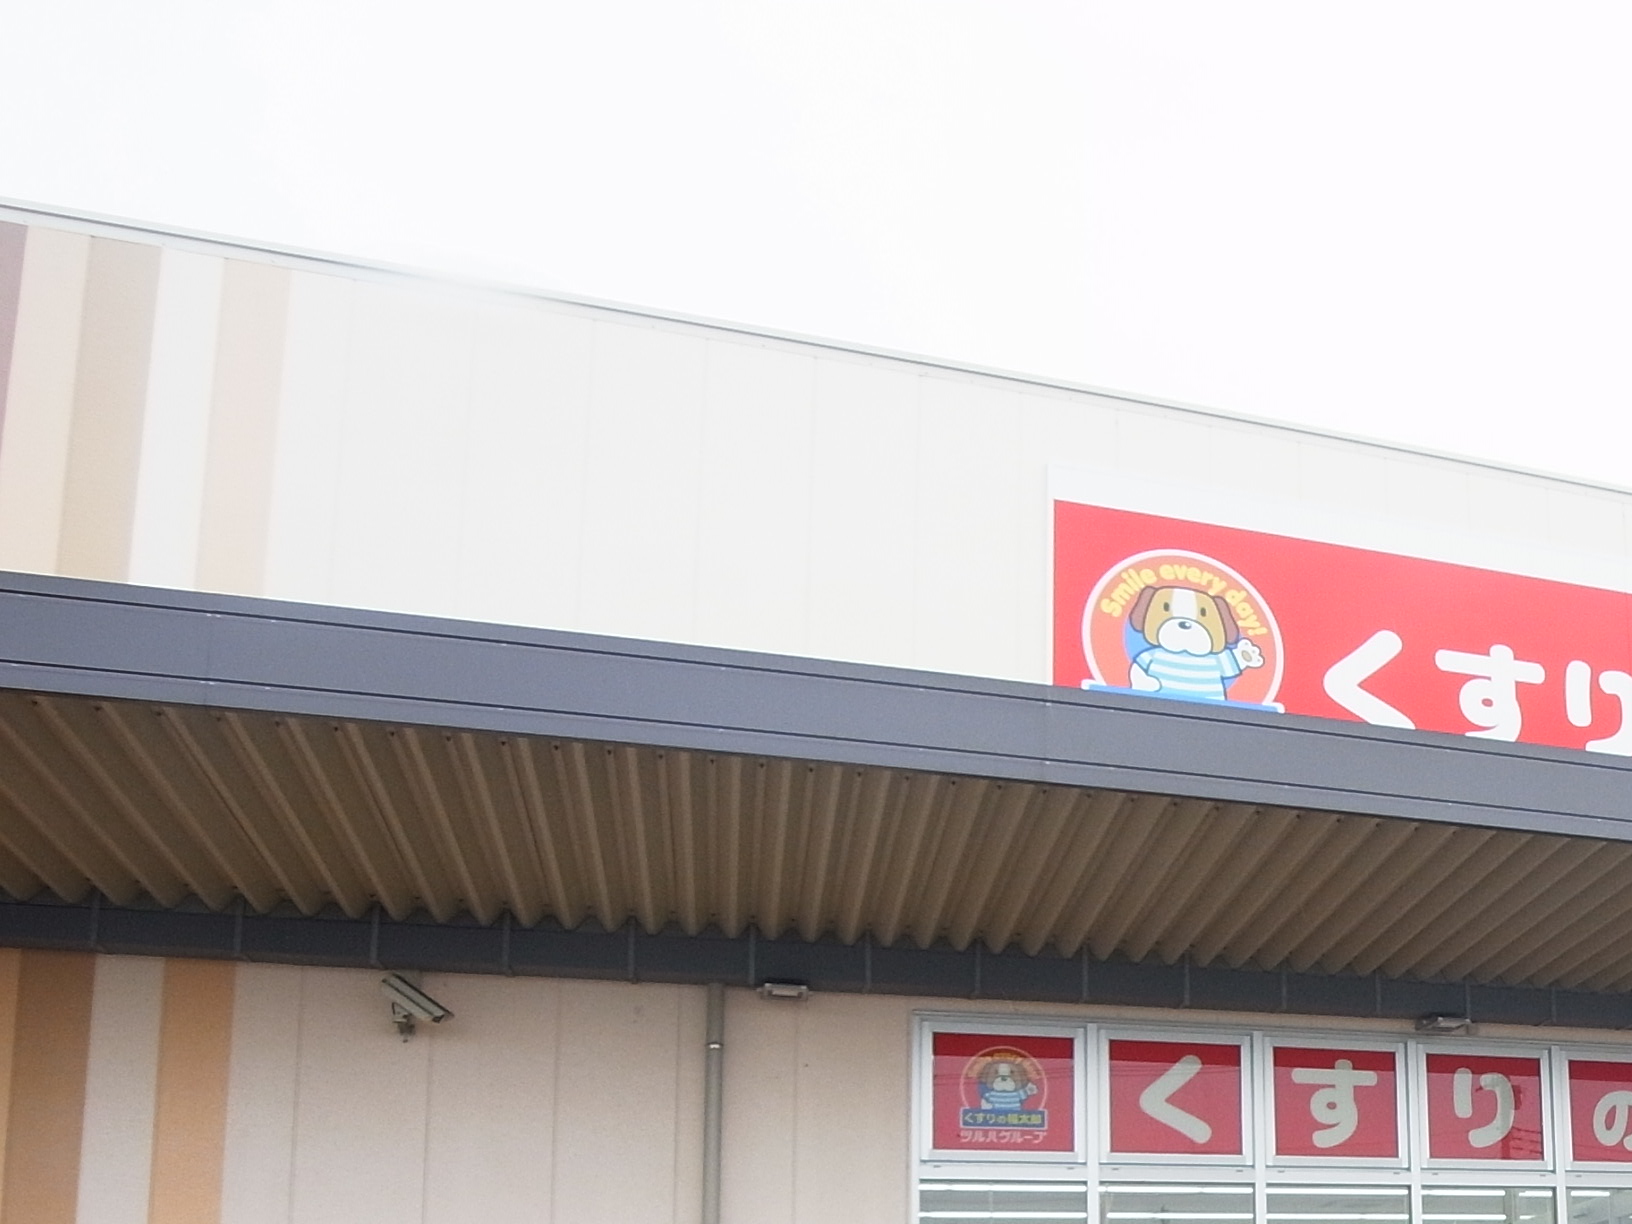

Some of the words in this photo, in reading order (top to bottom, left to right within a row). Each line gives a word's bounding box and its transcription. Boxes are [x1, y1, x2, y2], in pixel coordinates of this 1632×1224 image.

[1100, 568, 1157, 618] Smile
[1159, 564, 1227, 596] every
[1225, 588, 1268, 636] day!
[960, 1130, 1047, 1144] ツルハグループ
